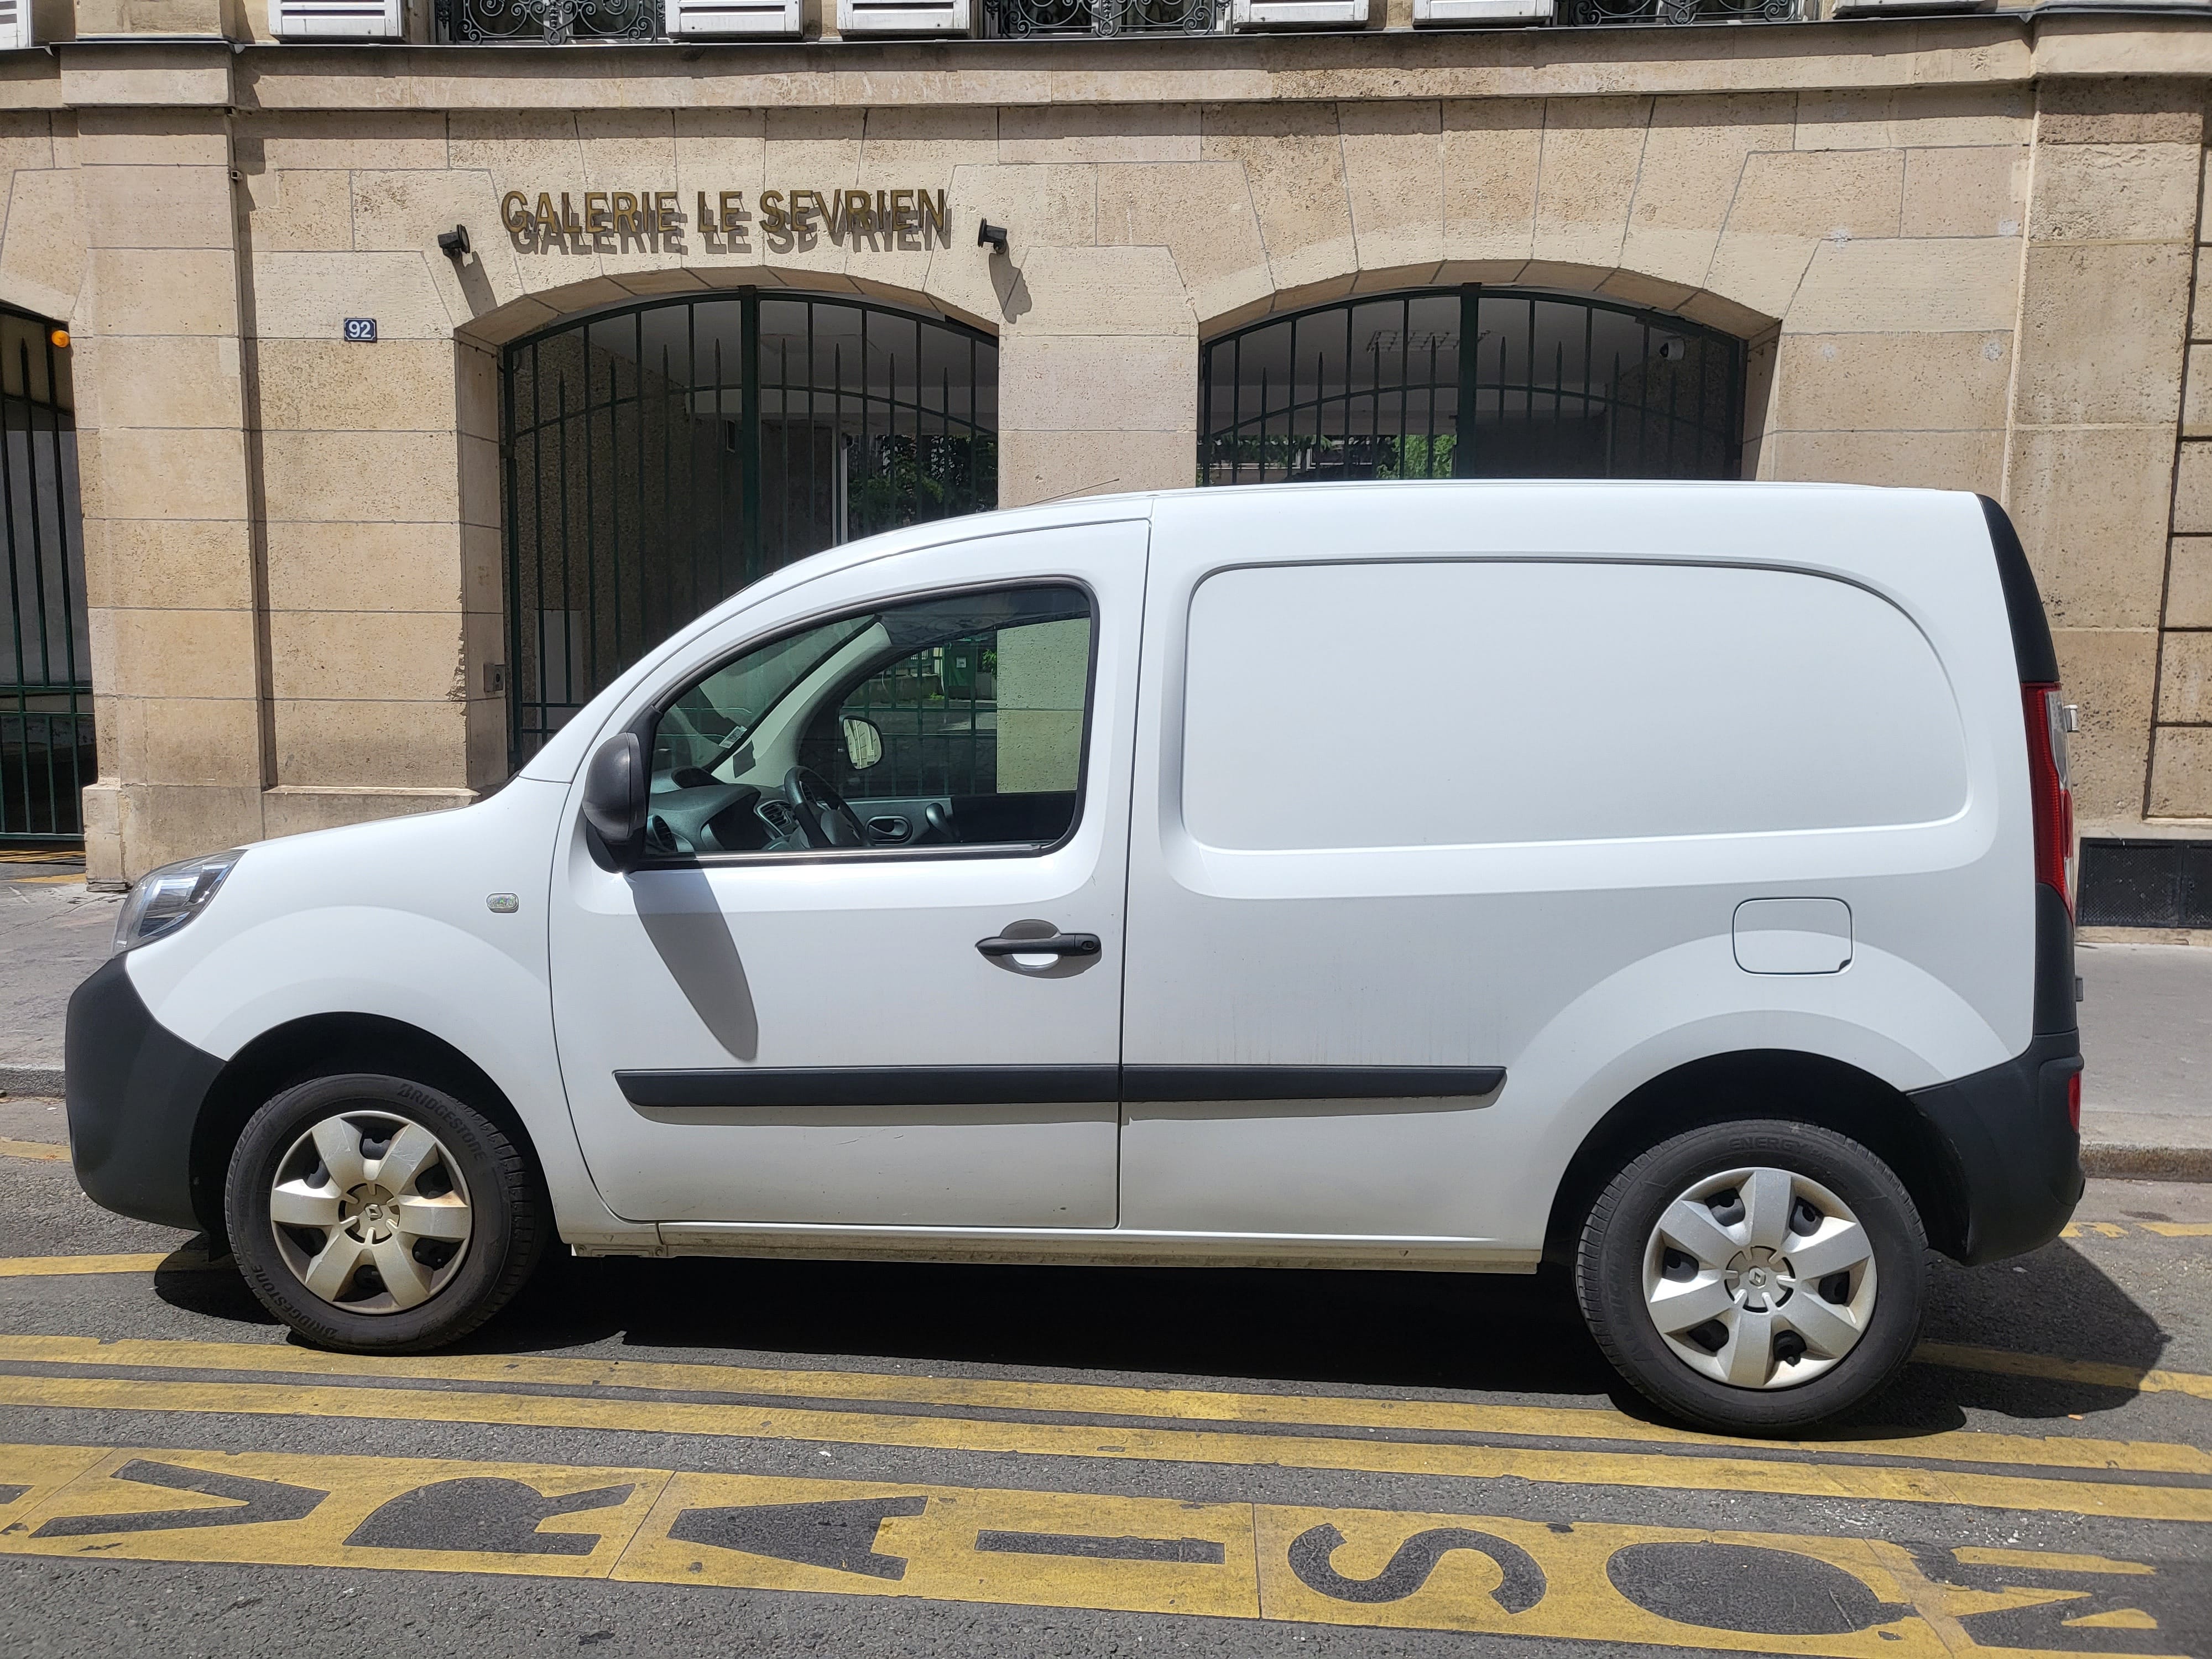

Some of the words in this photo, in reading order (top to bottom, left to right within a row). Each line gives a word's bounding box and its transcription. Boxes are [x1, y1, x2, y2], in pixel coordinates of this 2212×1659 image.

[501, 190, 678, 233] GALERIE
[698, 191, 742, 233] LE
[759, 189, 944, 232] SEVRIEN
[348, 321, 372, 338] 92
[397, 1083, 487, 1161] BRIDGESTONE
[1729, 1136, 1808, 1155] ENERGY
[252, 1264, 338, 1339] BRIDGESTONE
[0, 1458, 2159, 1652] VRAISON
